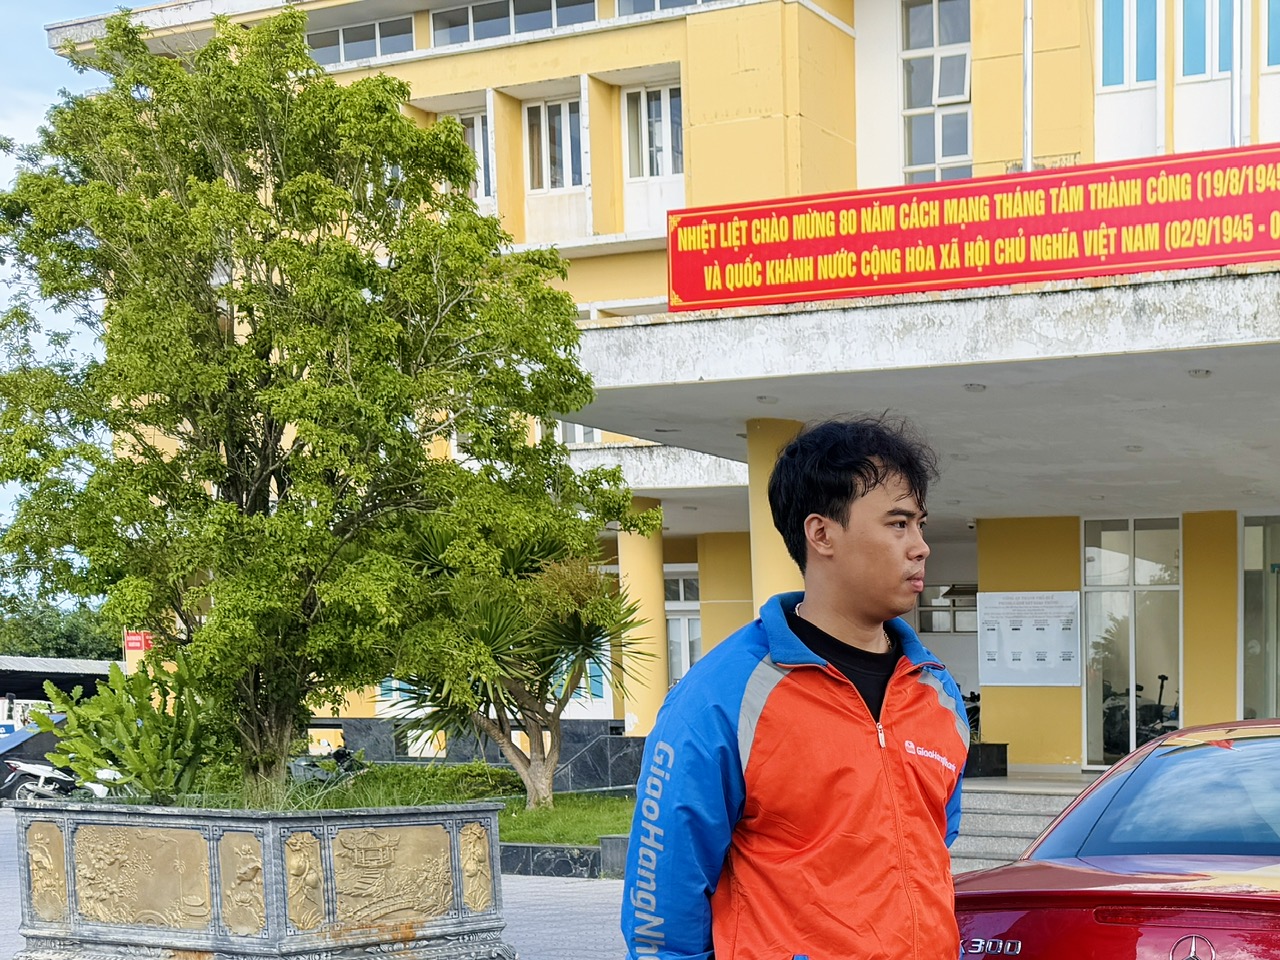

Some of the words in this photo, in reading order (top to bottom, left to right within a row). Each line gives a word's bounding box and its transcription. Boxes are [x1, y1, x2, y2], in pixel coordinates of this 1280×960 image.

[677, 222, 716, 254] NHIỆT
[720, 216, 747, 251] LIỆT
[751, 212, 788, 244] CHÀO
[793, 208, 835, 240] MỪNG
[839, 208, 857, 236] 80
[861, 201, 895, 233] NĂM
[900, 197, 939, 229] CÁCH
[944, 195, 989, 230] MẠNG
[994, 185, 1045, 219] THÁNG
[1050, 181, 1084, 214] TÁM
[1088, 175, 1141, 210] THÀNH
[1146, 169, 1191, 204] CÔNG
[704, 260, 721, 291] VÀ
[726, 253, 762, 291] QUỐC
[766, 251, 813, 285] KHÁNH
[818, 247, 856, 279] NƯỚC
[861, 244, 901, 281] CỘNG
[905, 240, 935, 272] HÒA
[940, 235, 960, 269] XÃ
[965, 234, 990, 272] HỘI
[995, 228, 1025, 264] CHỦ
[1030, 226, 1079, 261] NGHĨA
[1083, 222, 1117, 261] VIỆT
[1121, 223, 1159, 253] NAM
[1165, 214, 1253, 252] (02/9/1945
[1258, 223, 1265, 232] -
